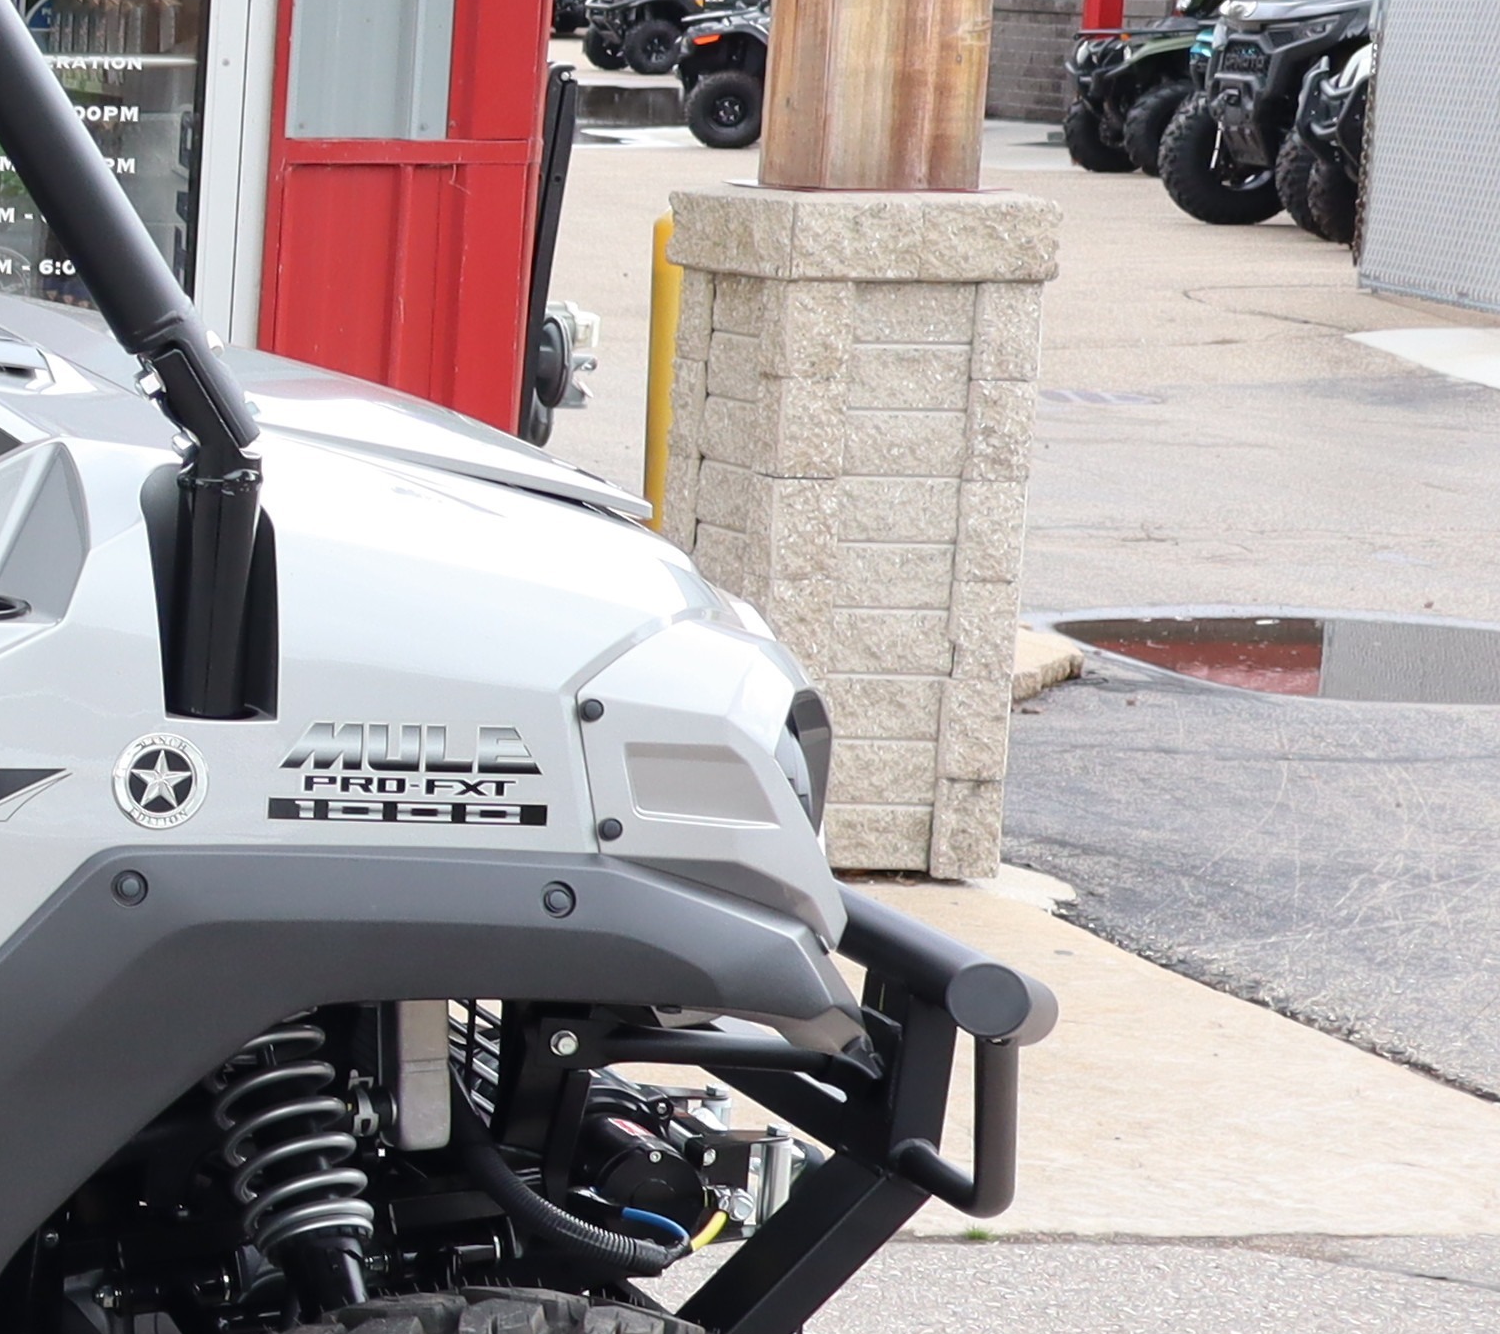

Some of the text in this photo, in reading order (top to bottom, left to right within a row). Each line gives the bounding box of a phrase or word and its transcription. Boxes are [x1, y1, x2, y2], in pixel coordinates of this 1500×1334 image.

[278, 721, 543, 776] MULE
[303, 775, 516, 797] PRO-FXT
[294, 799, 522, 823] 1000
